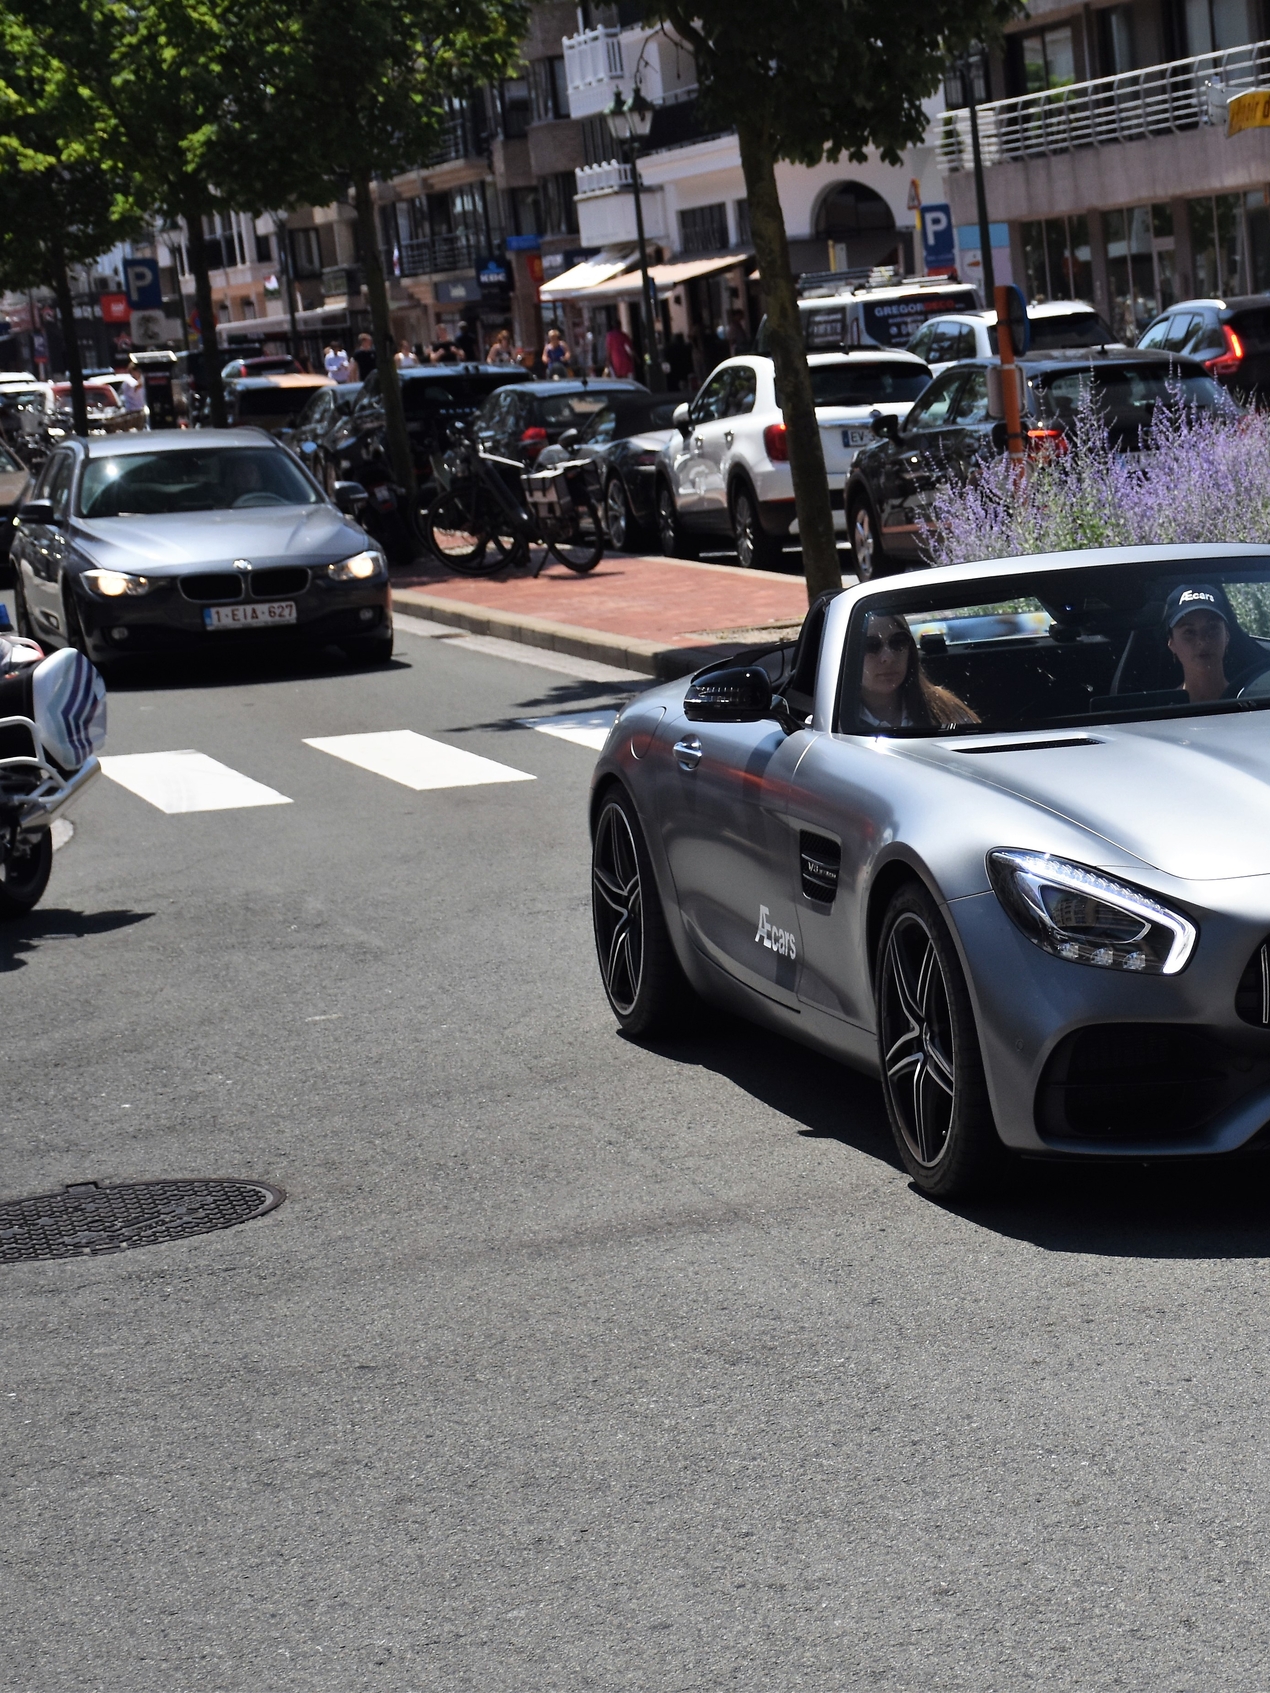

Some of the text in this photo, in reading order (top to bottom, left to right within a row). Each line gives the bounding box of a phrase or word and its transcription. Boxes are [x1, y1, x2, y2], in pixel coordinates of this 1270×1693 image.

[924, 210, 948, 246] P
[127, 265, 153, 302] P
[479, 272, 507, 283] KBC
[215, 603, 294, 623] 1-EIA-627
